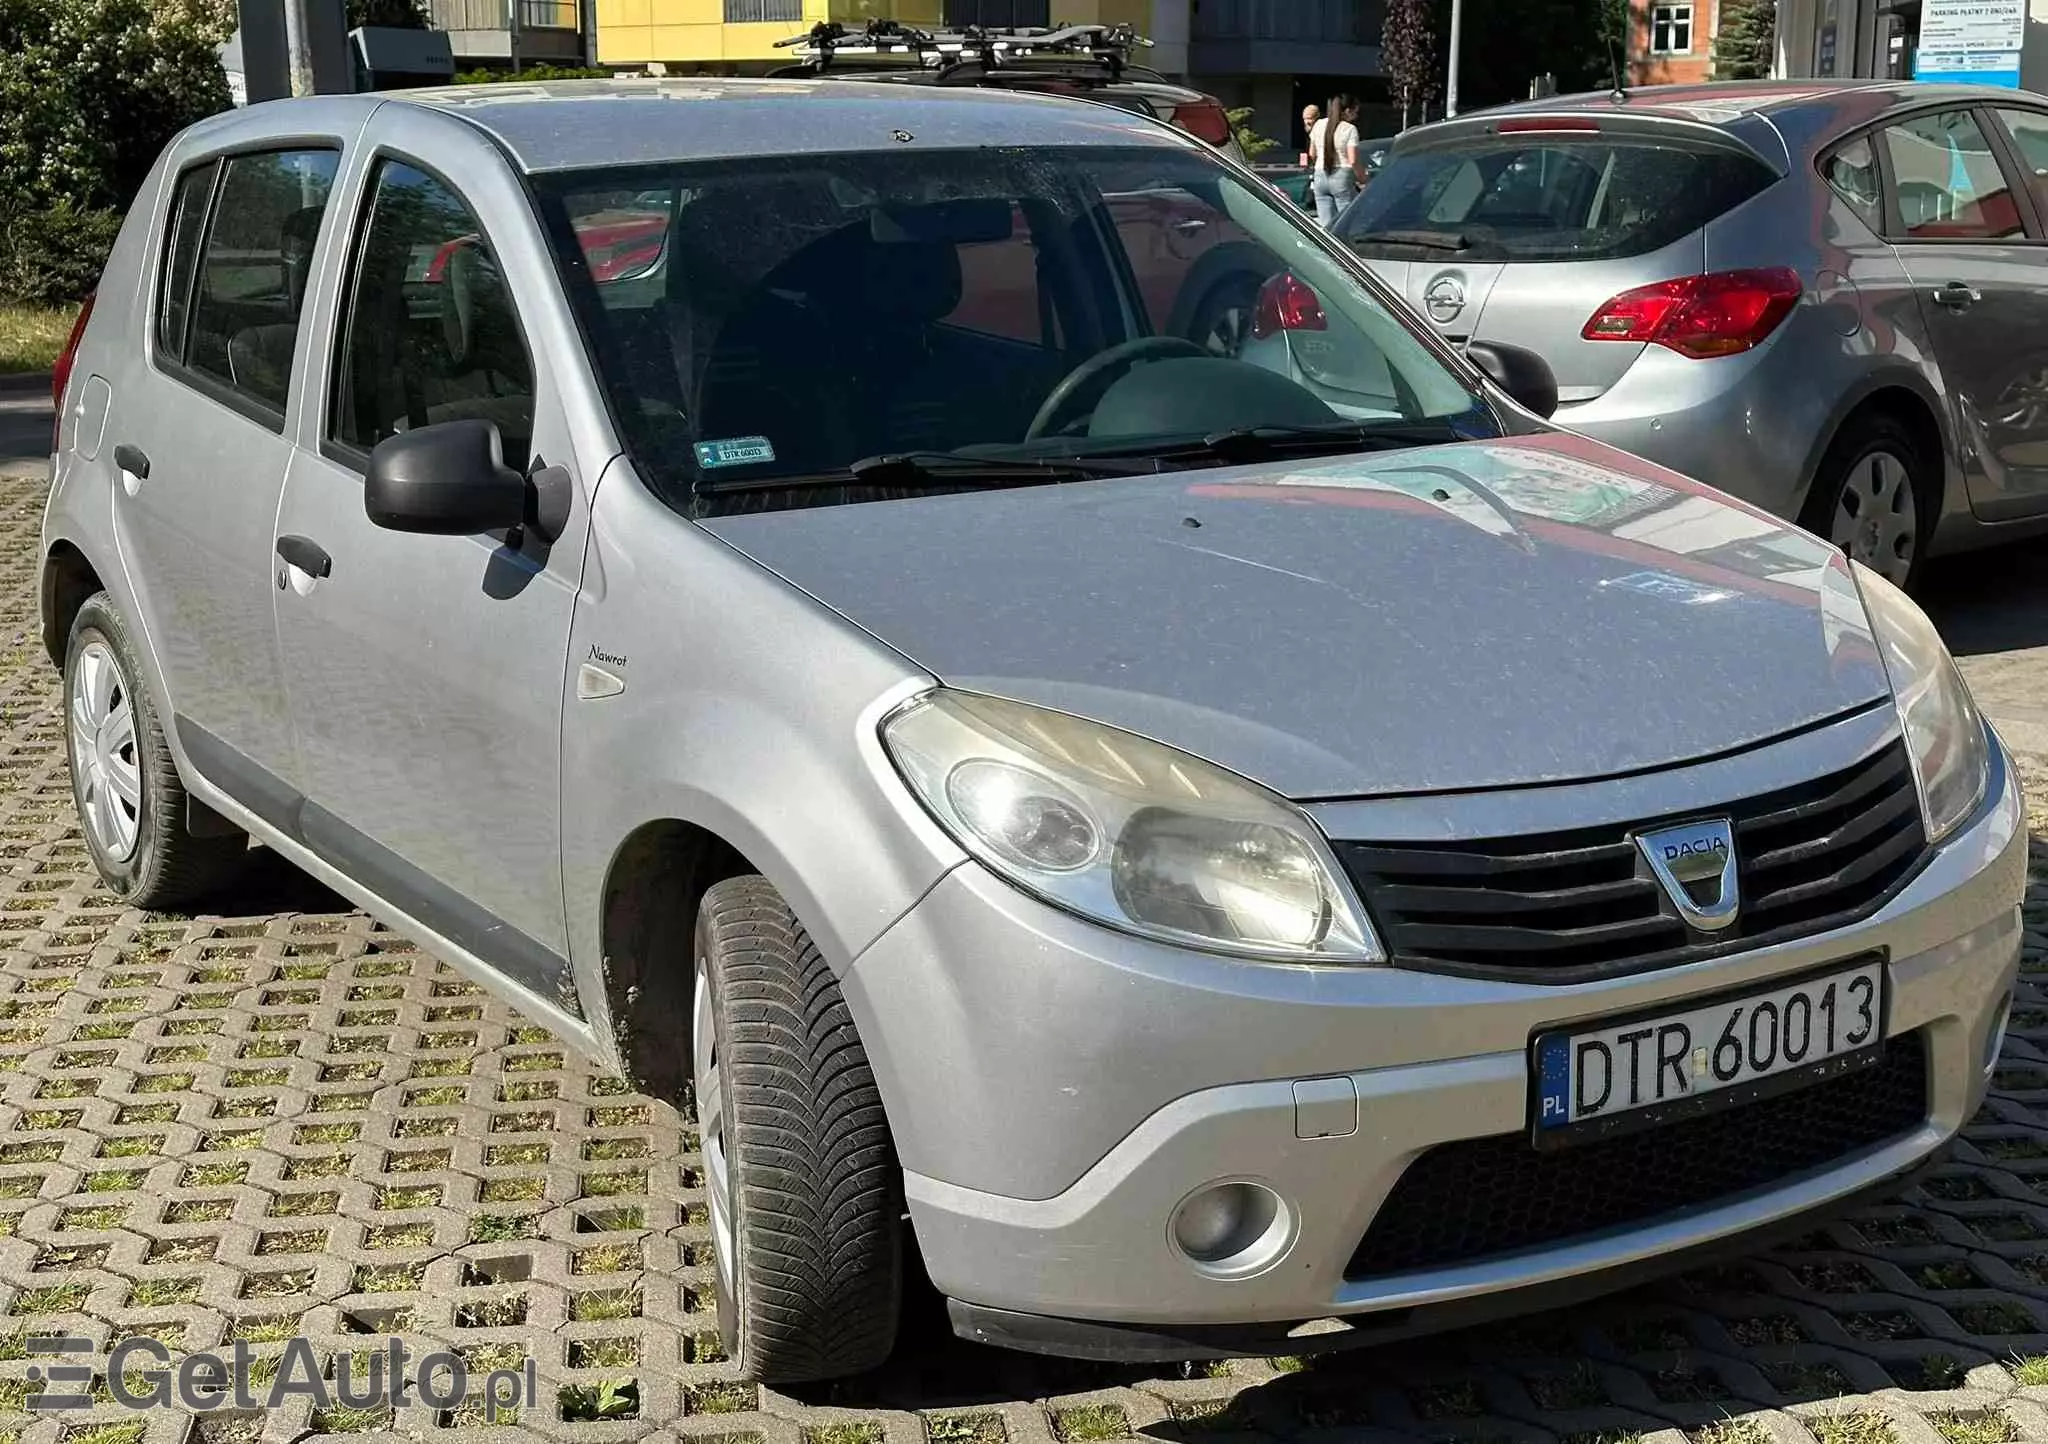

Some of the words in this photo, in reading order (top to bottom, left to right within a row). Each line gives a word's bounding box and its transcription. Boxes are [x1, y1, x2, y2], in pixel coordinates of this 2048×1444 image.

[588, 644, 627, 667] Nawrot
[1663, 836, 1726, 860] DACIA
[1575, 1022, 1692, 1117] DTR
[1712, 975, 1874, 1083] 60013
[1543, 1095, 1565, 1118] PL
